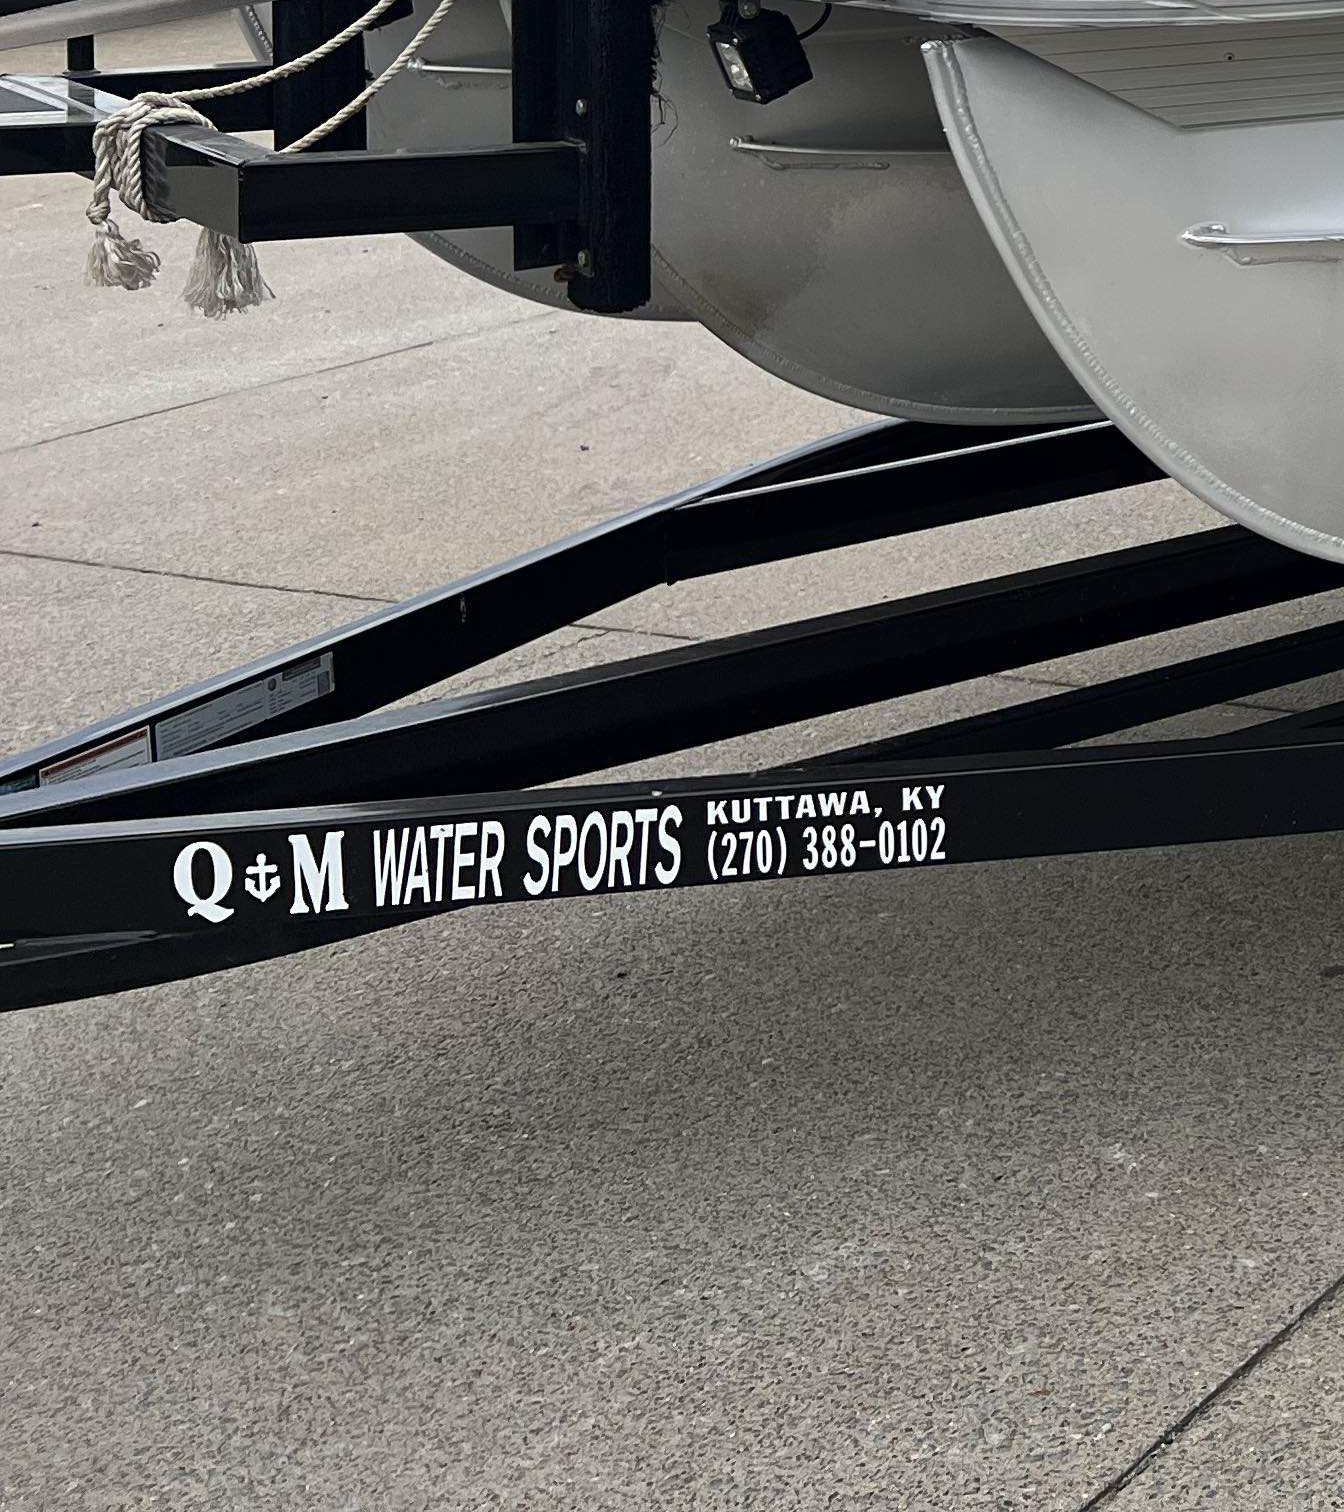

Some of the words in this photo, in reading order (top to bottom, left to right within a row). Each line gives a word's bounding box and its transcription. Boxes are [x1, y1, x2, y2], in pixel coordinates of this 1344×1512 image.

[706, 790, 883, 826] KUTTAWA,
[902, 784, 945, 811] KY
[173, 840, 235, 924] Q
[287, 830, 349, 915] M
[372, 820, 506, 908] WATER
[522, 804, 684, 896] SPORTS
[706, 826, 788, 881] (270)
[802, 816, 946, 871] 388-0102
